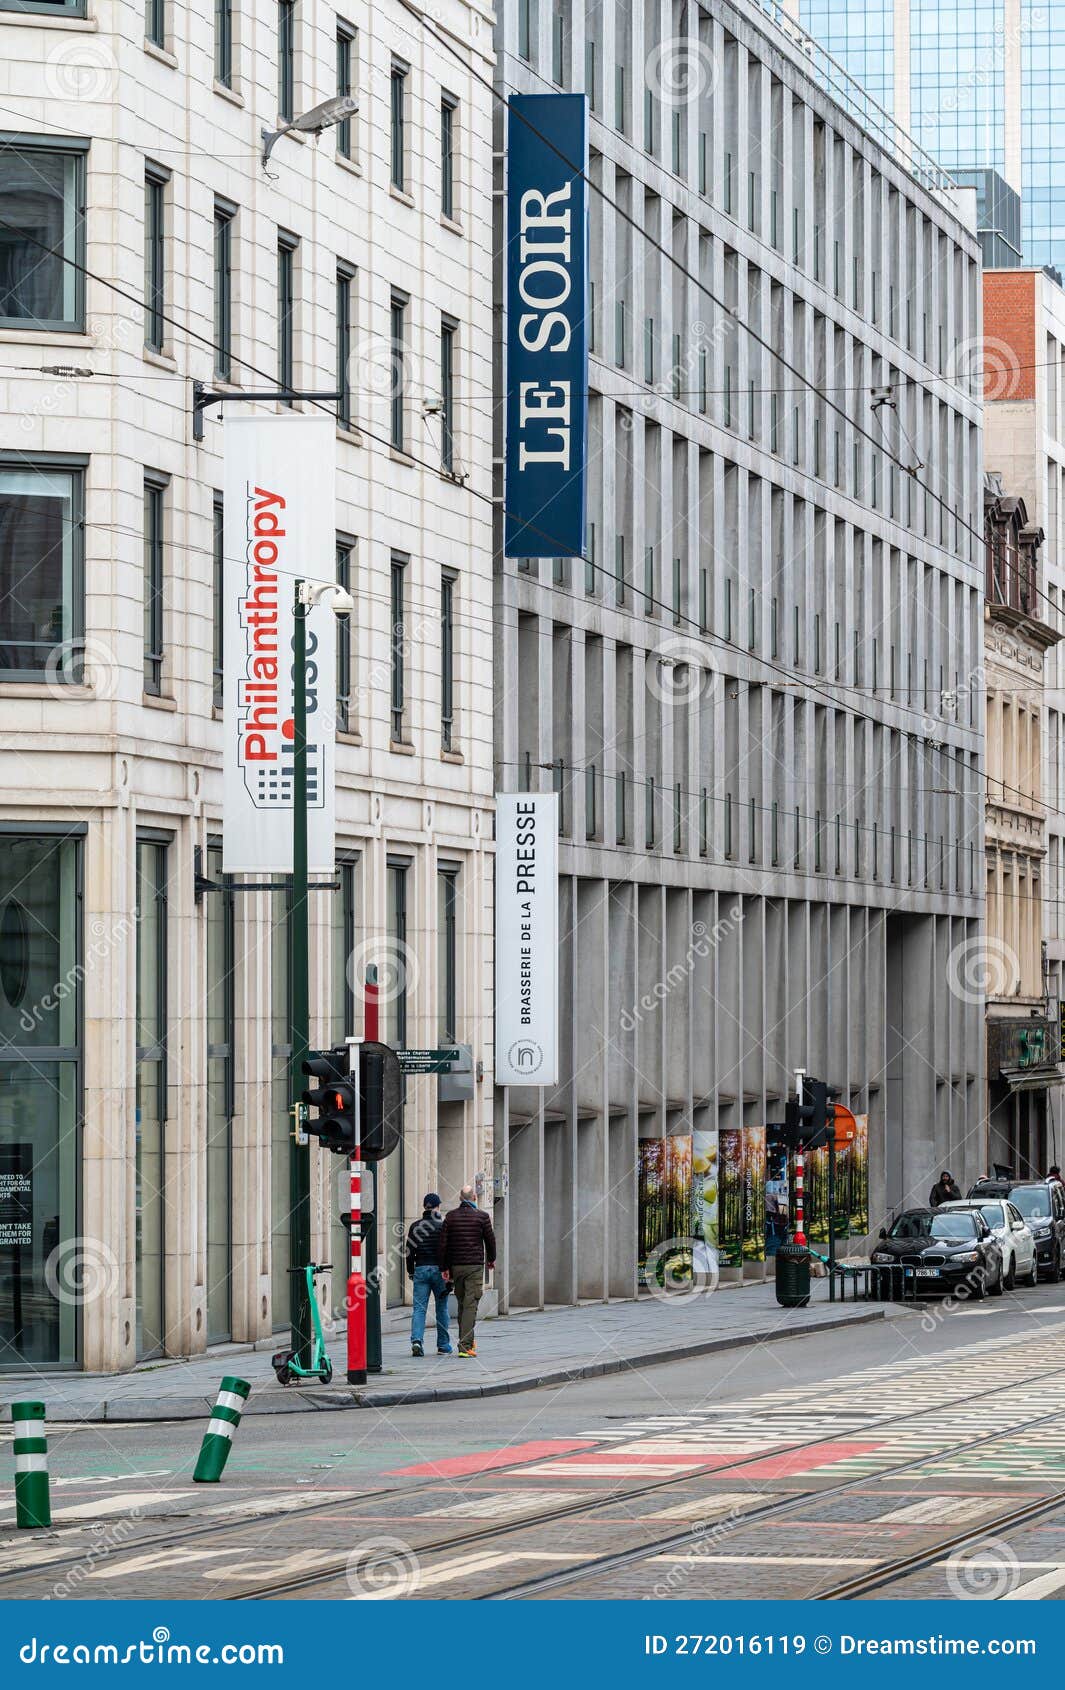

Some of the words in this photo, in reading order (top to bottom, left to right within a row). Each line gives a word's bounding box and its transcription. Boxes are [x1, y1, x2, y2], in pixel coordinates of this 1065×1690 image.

[518, 182, 572, 353] SOIR
[519, 380, 571, 472] LE
[245, 486, 286, 761] Philanthropy
[516, 802, 536, 894] PRESSE
[521, 901, 531, 911] LA
[521, 923, 531, 941] DE
[520, 947, 531, 1025] BRASSERIE
[14, 1222, 32, 1230] TAKE
